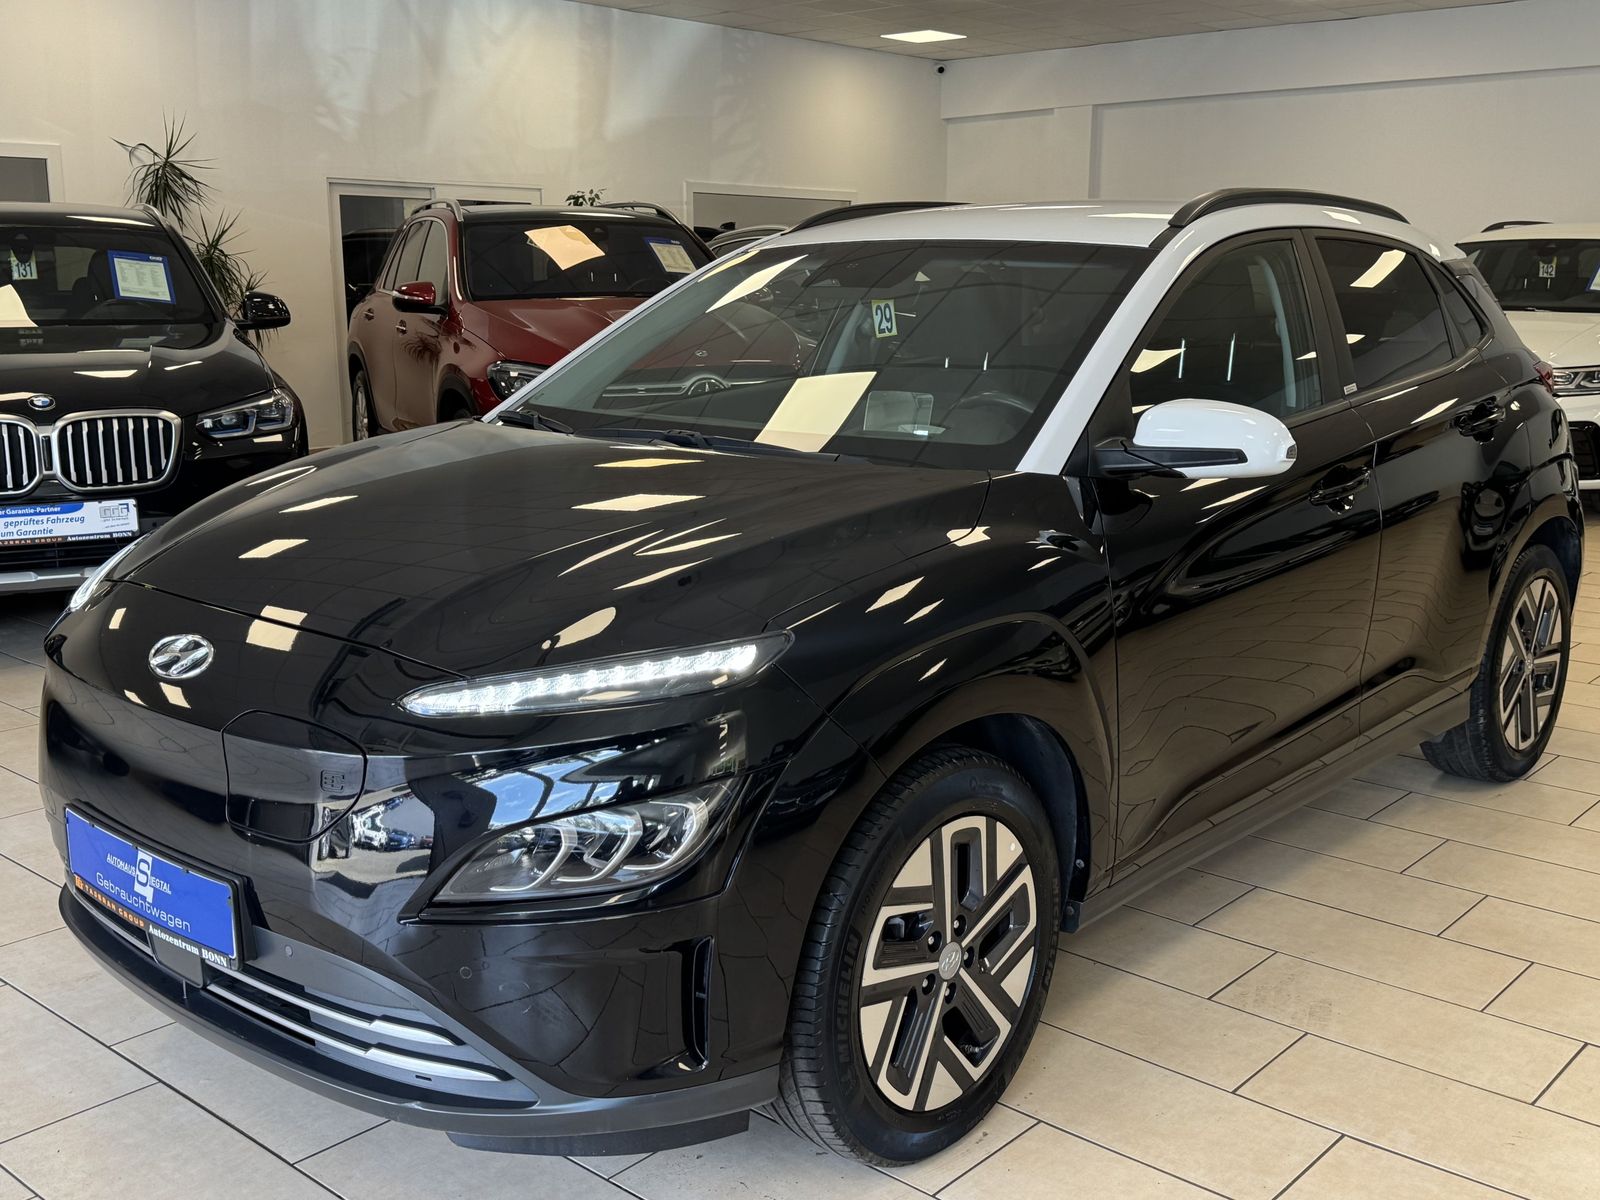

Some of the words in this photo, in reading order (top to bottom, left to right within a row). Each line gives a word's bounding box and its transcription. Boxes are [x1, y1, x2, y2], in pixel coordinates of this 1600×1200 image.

[15, 261, 33, 278] 131
[1542, 264, 1554, 276] 142
[875, 303, 893, 334] 29
[6, 506, 61, 515] Garantie-Partner
[4, 517, 45, 529] geprüftes
[46, 516, 85, 525] Fahrzeug
[16, 527, 54, 537] Garantie
[106, 853, 136, 877] AUTOHAUS
[96, 872, 191, 932] Gebrauchtwagen
[118, 907, 145, 928] GROUP
[149, 924, 200, 955] Autozentrum
[201, 948, 227, 967] BONN
[836, 927, 861, 1063] MICHELIN
